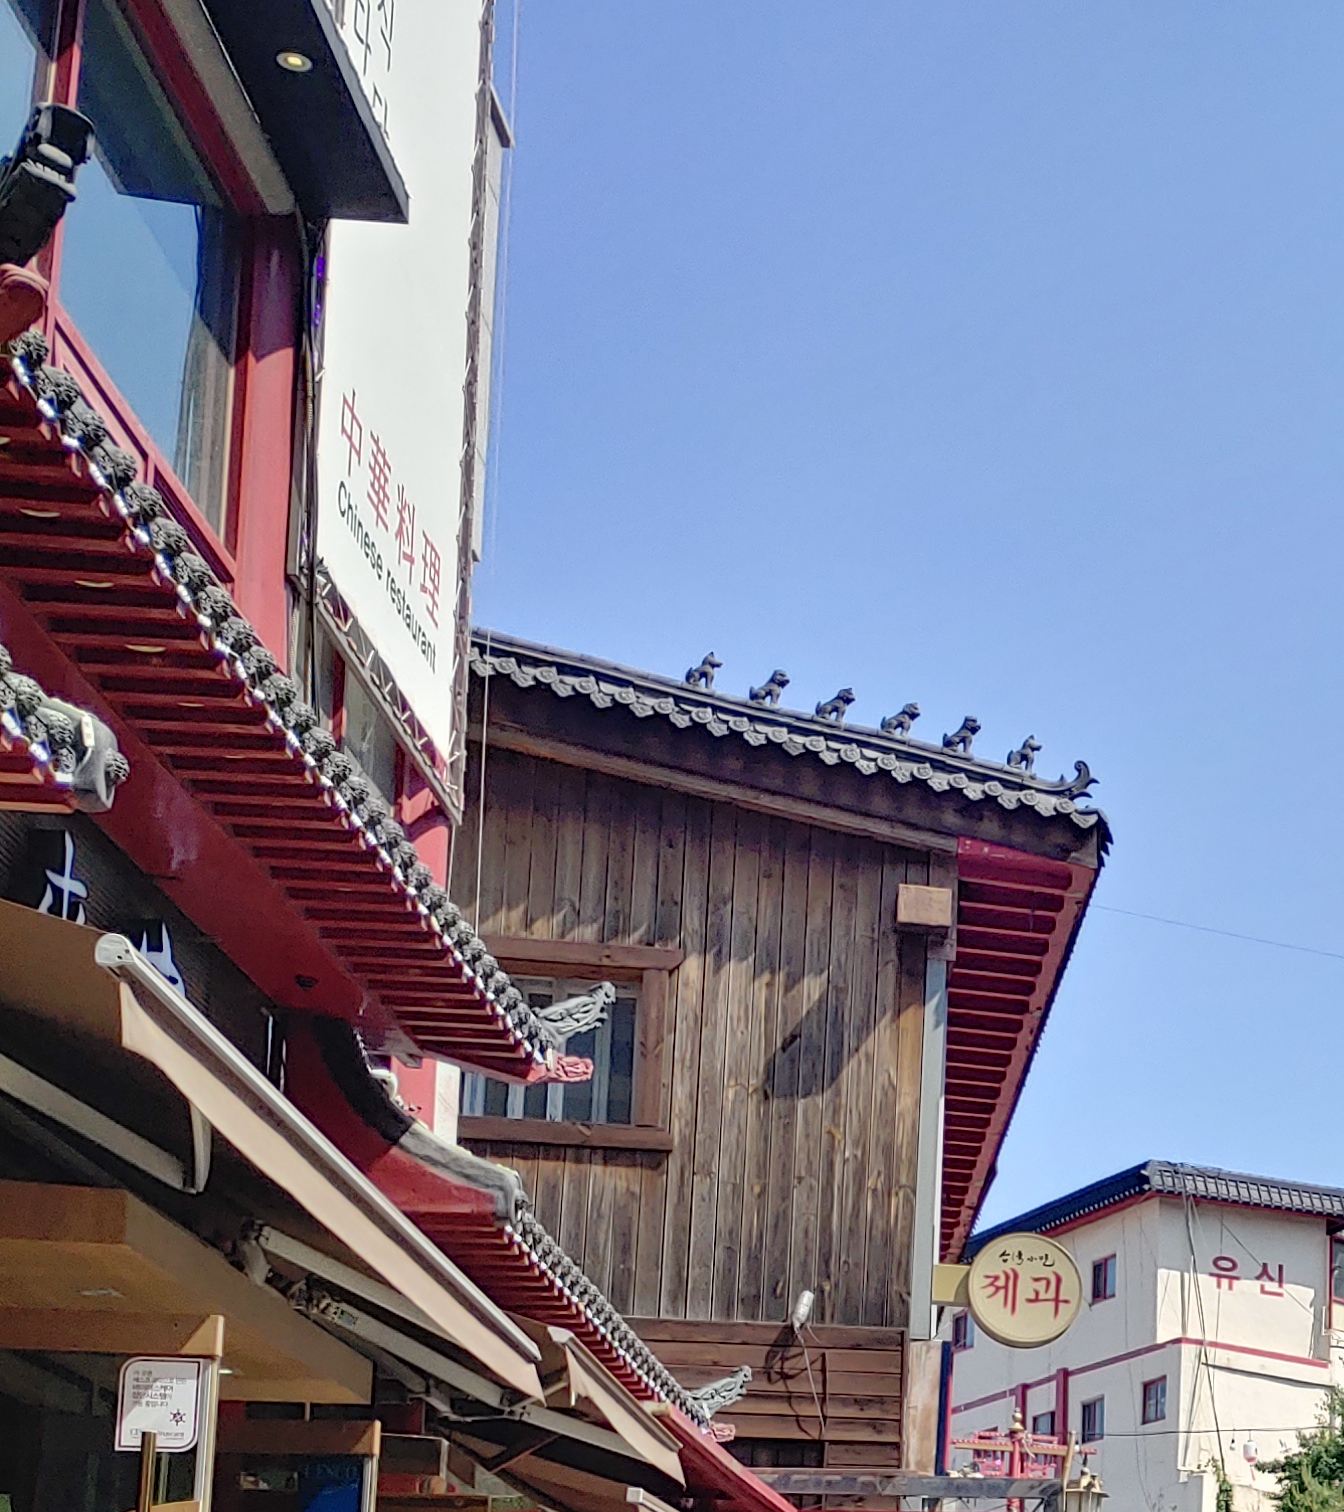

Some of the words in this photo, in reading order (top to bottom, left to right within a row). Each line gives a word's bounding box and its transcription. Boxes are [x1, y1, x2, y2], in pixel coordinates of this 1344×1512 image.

[340, 388, 442, 629] 中華料理
[337, 480, 384, 581] Chinese
[385, 566, 437, 674] restaurant
[980, 1267, 1071, 1321] 제과
[1209, 1256, 1284, 1298] 유신
